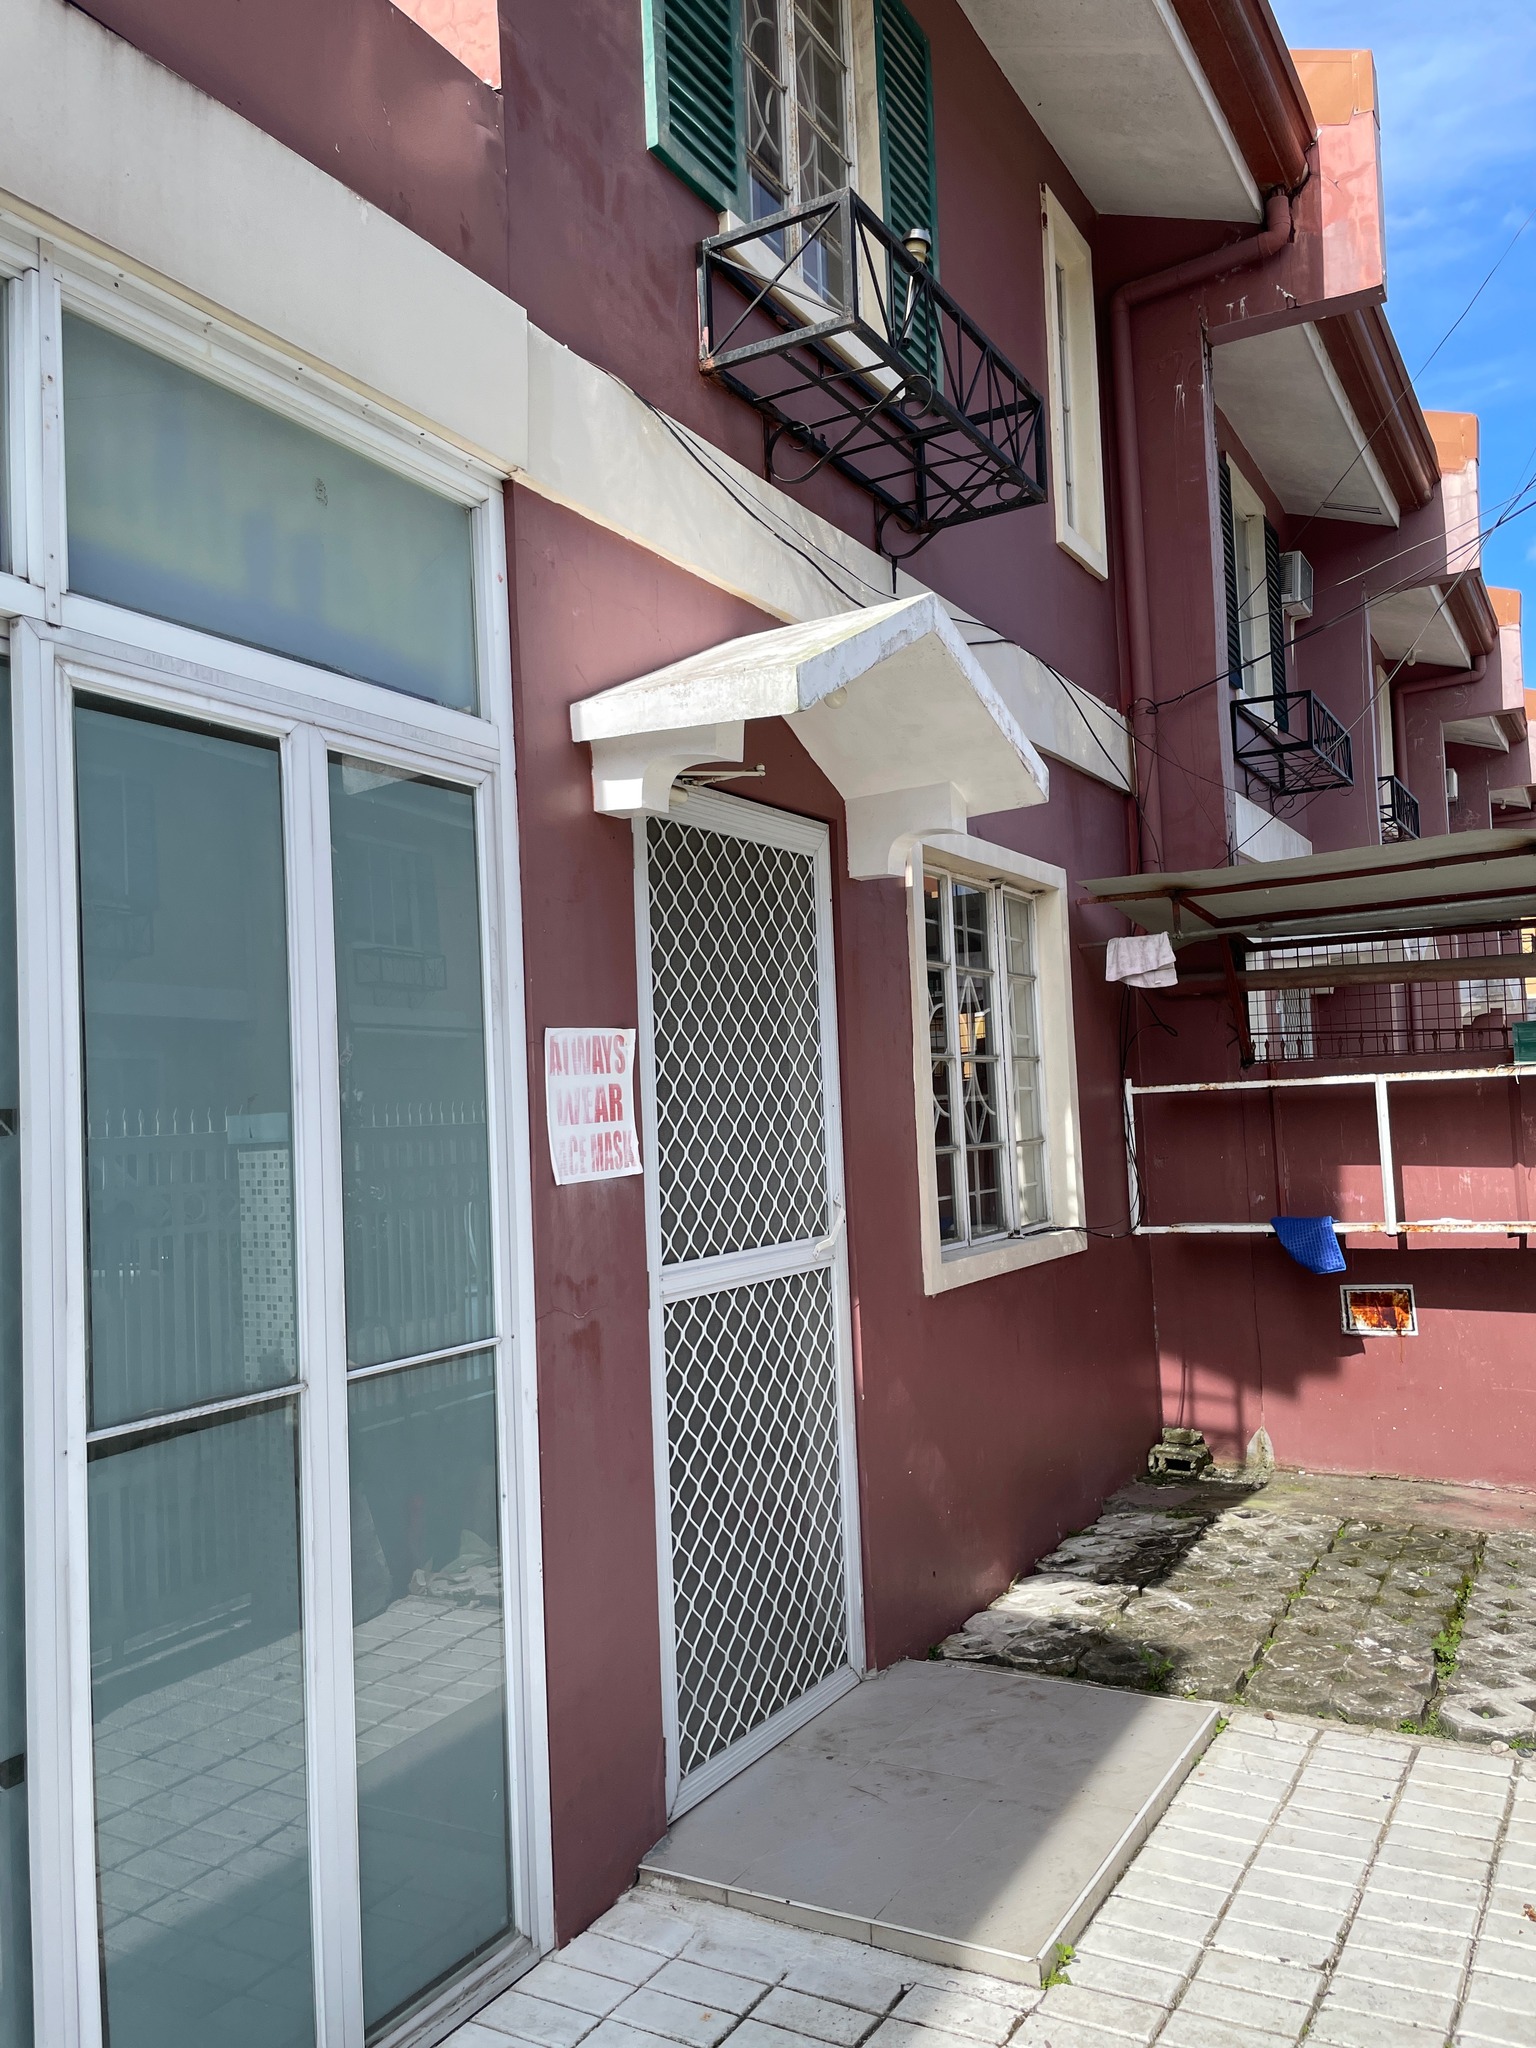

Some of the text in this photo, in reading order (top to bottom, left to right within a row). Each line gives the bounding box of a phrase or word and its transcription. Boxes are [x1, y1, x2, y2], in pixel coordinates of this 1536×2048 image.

[556, 1083, 624, 1126] WEAR
[556, 1130, 636, 1177] ACE MASK
